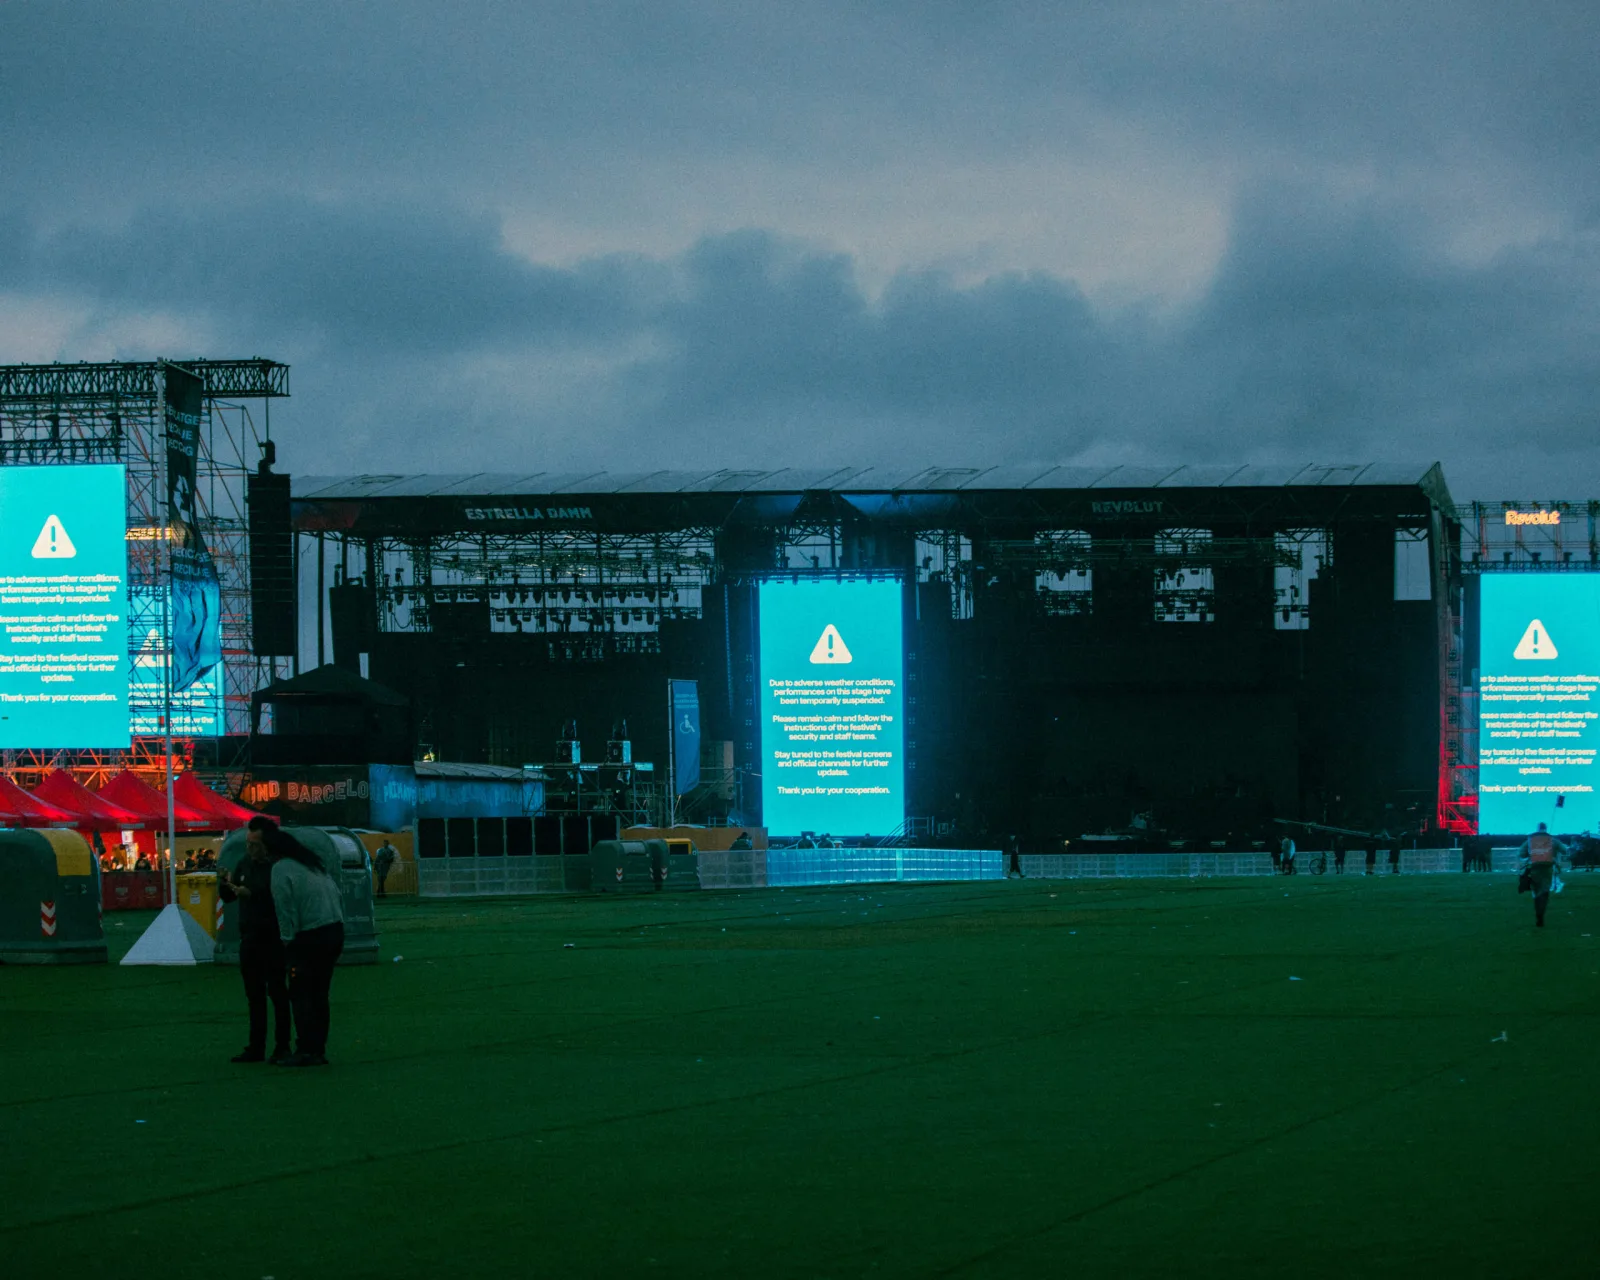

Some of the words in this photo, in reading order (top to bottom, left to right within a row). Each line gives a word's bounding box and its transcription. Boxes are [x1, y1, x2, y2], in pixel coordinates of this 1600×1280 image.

[1092, 501, 1163, 513] REVOLUT
[465, 507, 544, 520] ESTRELLA
[547, 507, 593, 519] DAMM
[1506, 510, 1560, 525] Revolut
[79, 574, 121, 583] conditions,
[0, 585, 49, 593] erformances
[59, 584, 75, 592] this
[75, 585, 97, 594] stage
[97, 584, 117, 592] have
[21, 594, 65, 604] temporarily
[65, 594, 110, 604] suspended.
[81, 614, 106, 622] follow
[6, 624, 51, 632] instructions
[73, 624, 107, 632] festival's
[11, 634, 42, 644] security
[58, 634, 77, 642] staff
[59, 654, 88, 662] festival
[15, 664, 41, 672] official
[76, 663, 88, 672] for
[88, 663, 115, 671] further
[41, 674, 74, 683] updates.
[855, 678, 895, 686] conditions,
[774, 688, 825, 696] performances
[851, 688, 872, 696] stage
[1555, 685, 1577, 693] stage
[0, 693, 24, 702] Thank
[39, 693, 51, 701] for
[70, 693, 117, 703] cooperation.
[800, 697, 841, 706] temporarily
[1502, 693, 1546, 702] temporarily
[1545, 693, 1590, 702] suspended.
[789, 733, 818, 742] security
[1491, 730, 1521, 738] security
[775, 751, 790, 760] Stay
[817, 769, 849, 777] updates.
[1519, 766, 1551, 775] updates.
[287, 779, 370, 804] BARCELO
[845, 786, 890, 795] cooperation.
[1546, 784, 1593, 793] cooperation.
